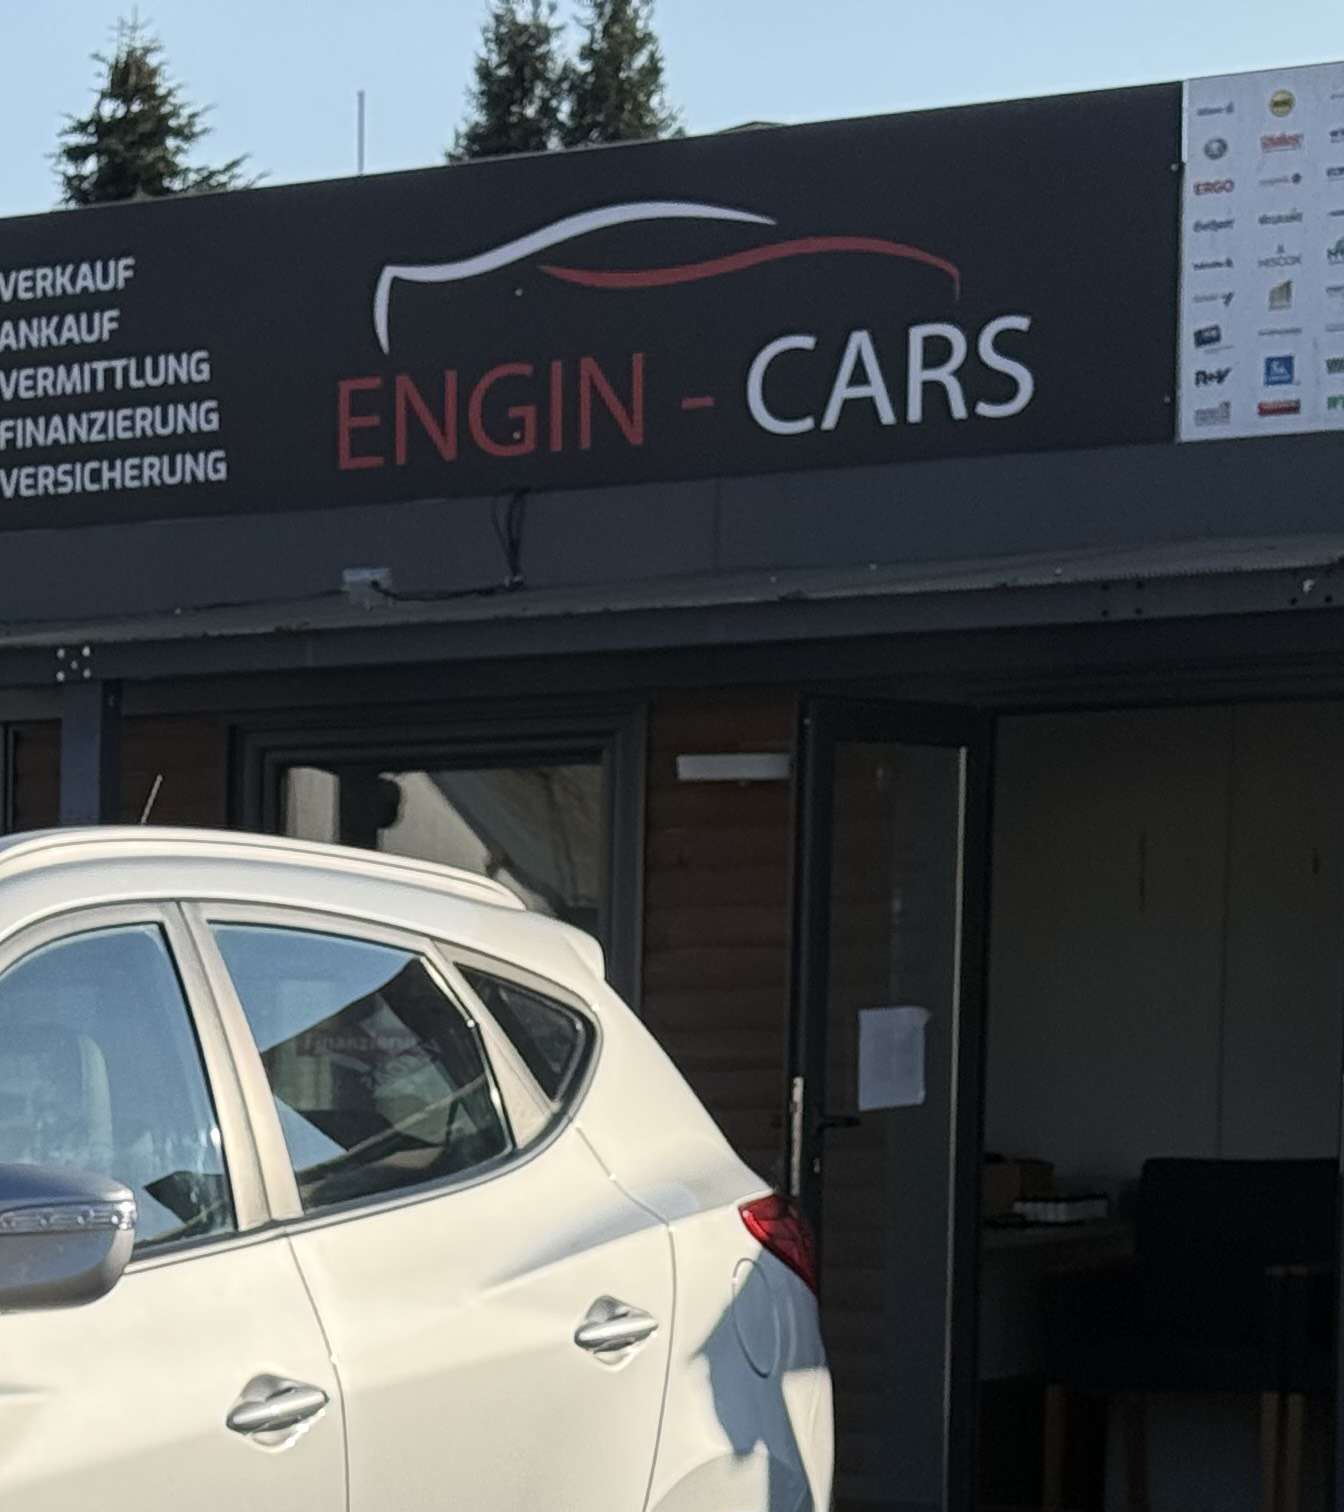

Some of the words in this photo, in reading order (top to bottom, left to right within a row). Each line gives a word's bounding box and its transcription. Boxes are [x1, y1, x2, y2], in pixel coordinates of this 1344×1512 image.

[1193, 179, 1234, 196] ERGO
[337, 352, 647, 471] ENGIN
[680, 396, 714, 410] -
[746, 315, 1035, 436] CARS
